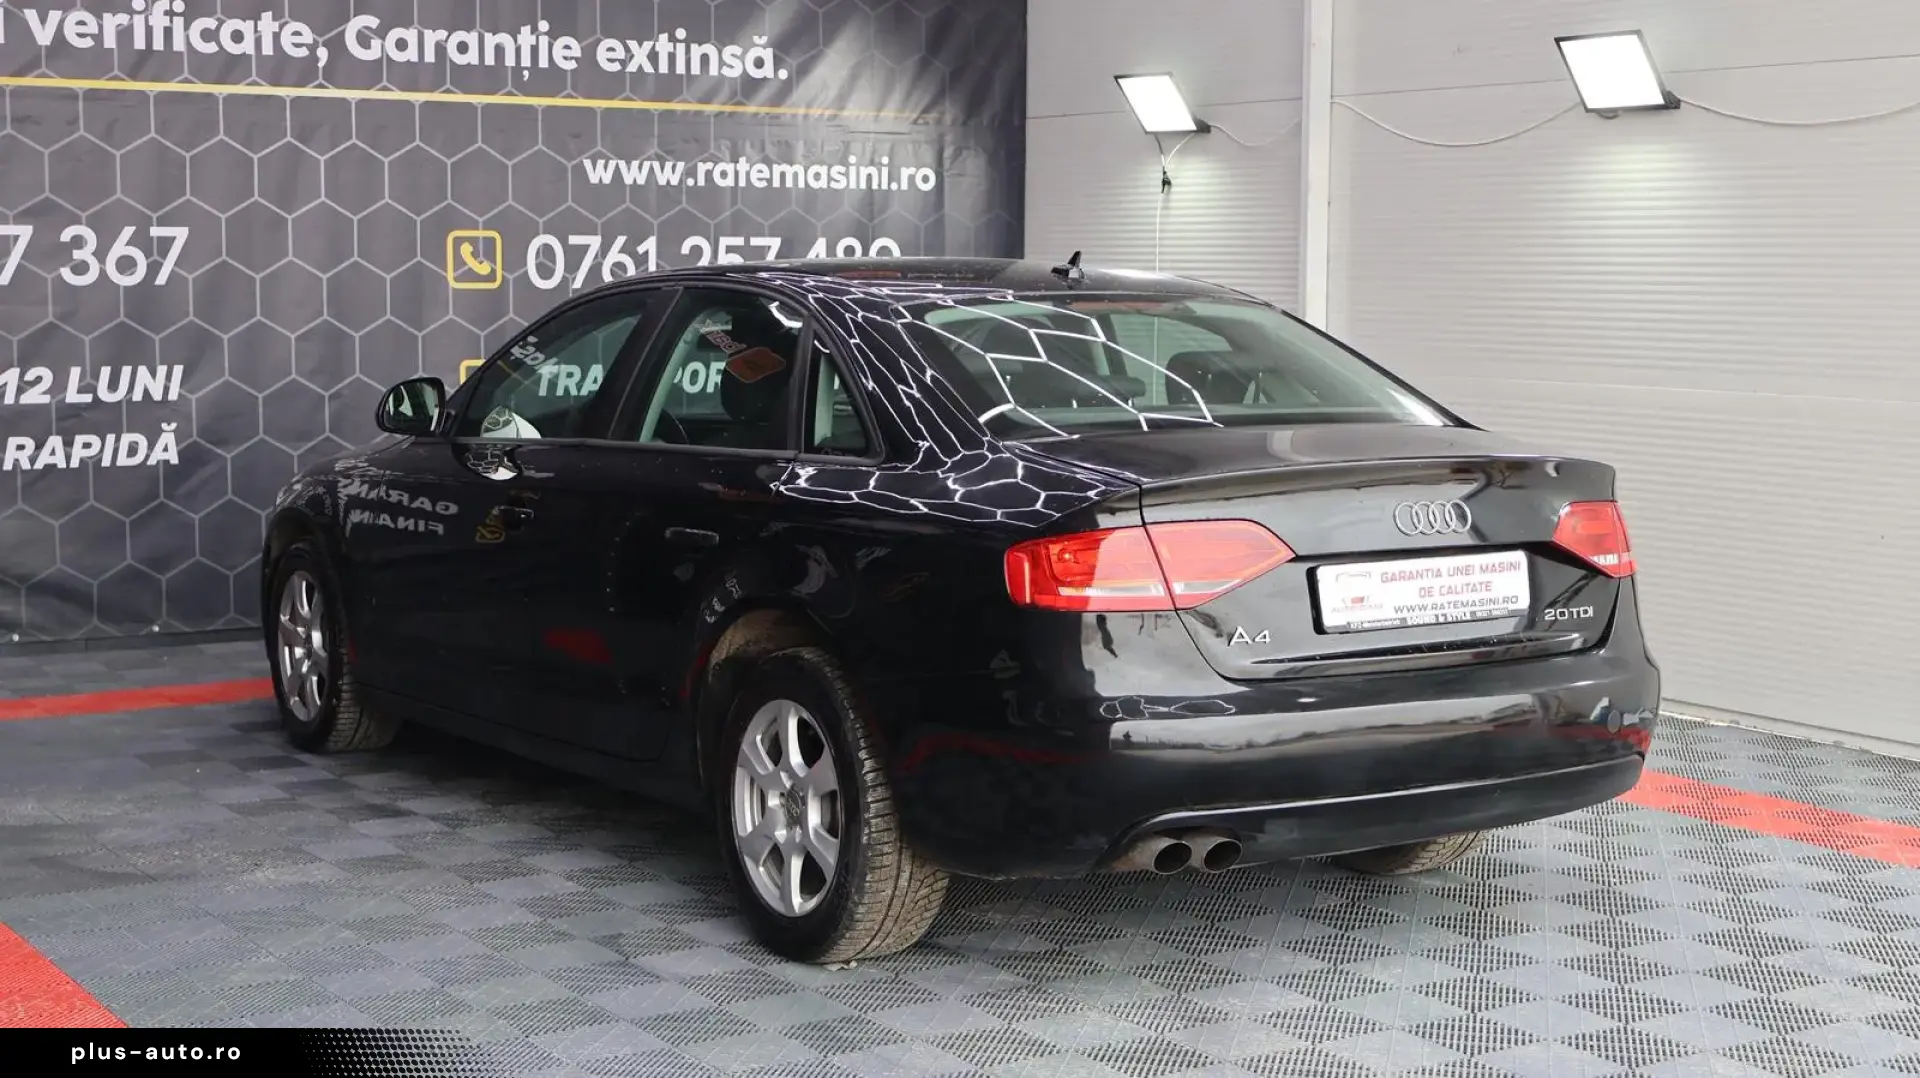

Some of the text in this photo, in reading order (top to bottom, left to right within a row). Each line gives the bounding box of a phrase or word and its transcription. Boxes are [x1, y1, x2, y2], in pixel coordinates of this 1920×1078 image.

[23, 0, 328, 68] verificate,
[344, 14, 582, 81] Garanție
[596, 28, 788, 80] extinsă.
[583, 155, 937, 192] www.ratemasini.ro
[59, 224, 190, 287] 367
[526, 234, 657, 289] 0761
[0, 364, 184, 405] 12 LUNI
[2, 422, 180, 471] RAPIDĂ
[1380, 560, 1521, 583] GARANTIA UNEI MASINI
[1419, 581, 1492, 598] DE CALITATE
[1394, 595, 1519, 614] WWW.RATEMASINI.RO
